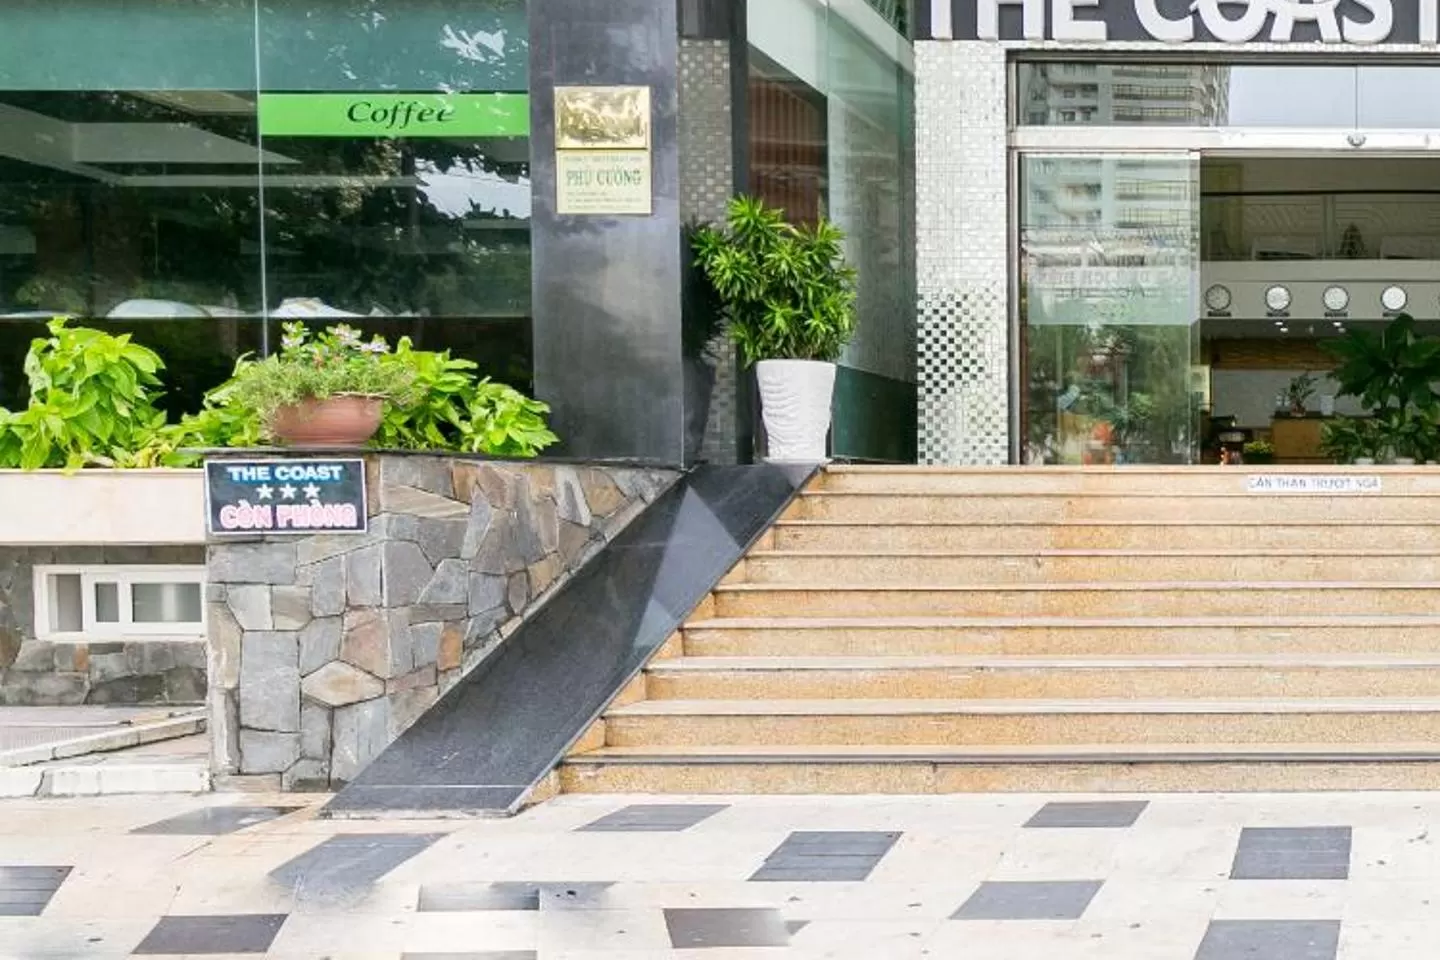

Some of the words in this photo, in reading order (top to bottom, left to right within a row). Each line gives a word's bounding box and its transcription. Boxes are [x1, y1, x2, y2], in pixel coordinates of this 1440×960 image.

[347, 101, 455, 130] Coffee
[226, 466, 271, 481] THE
[274, 465, 344, 481] COAST
[219, 499, 274, 529] CÒN
[275, 498, 358, 529] PHÒNG
